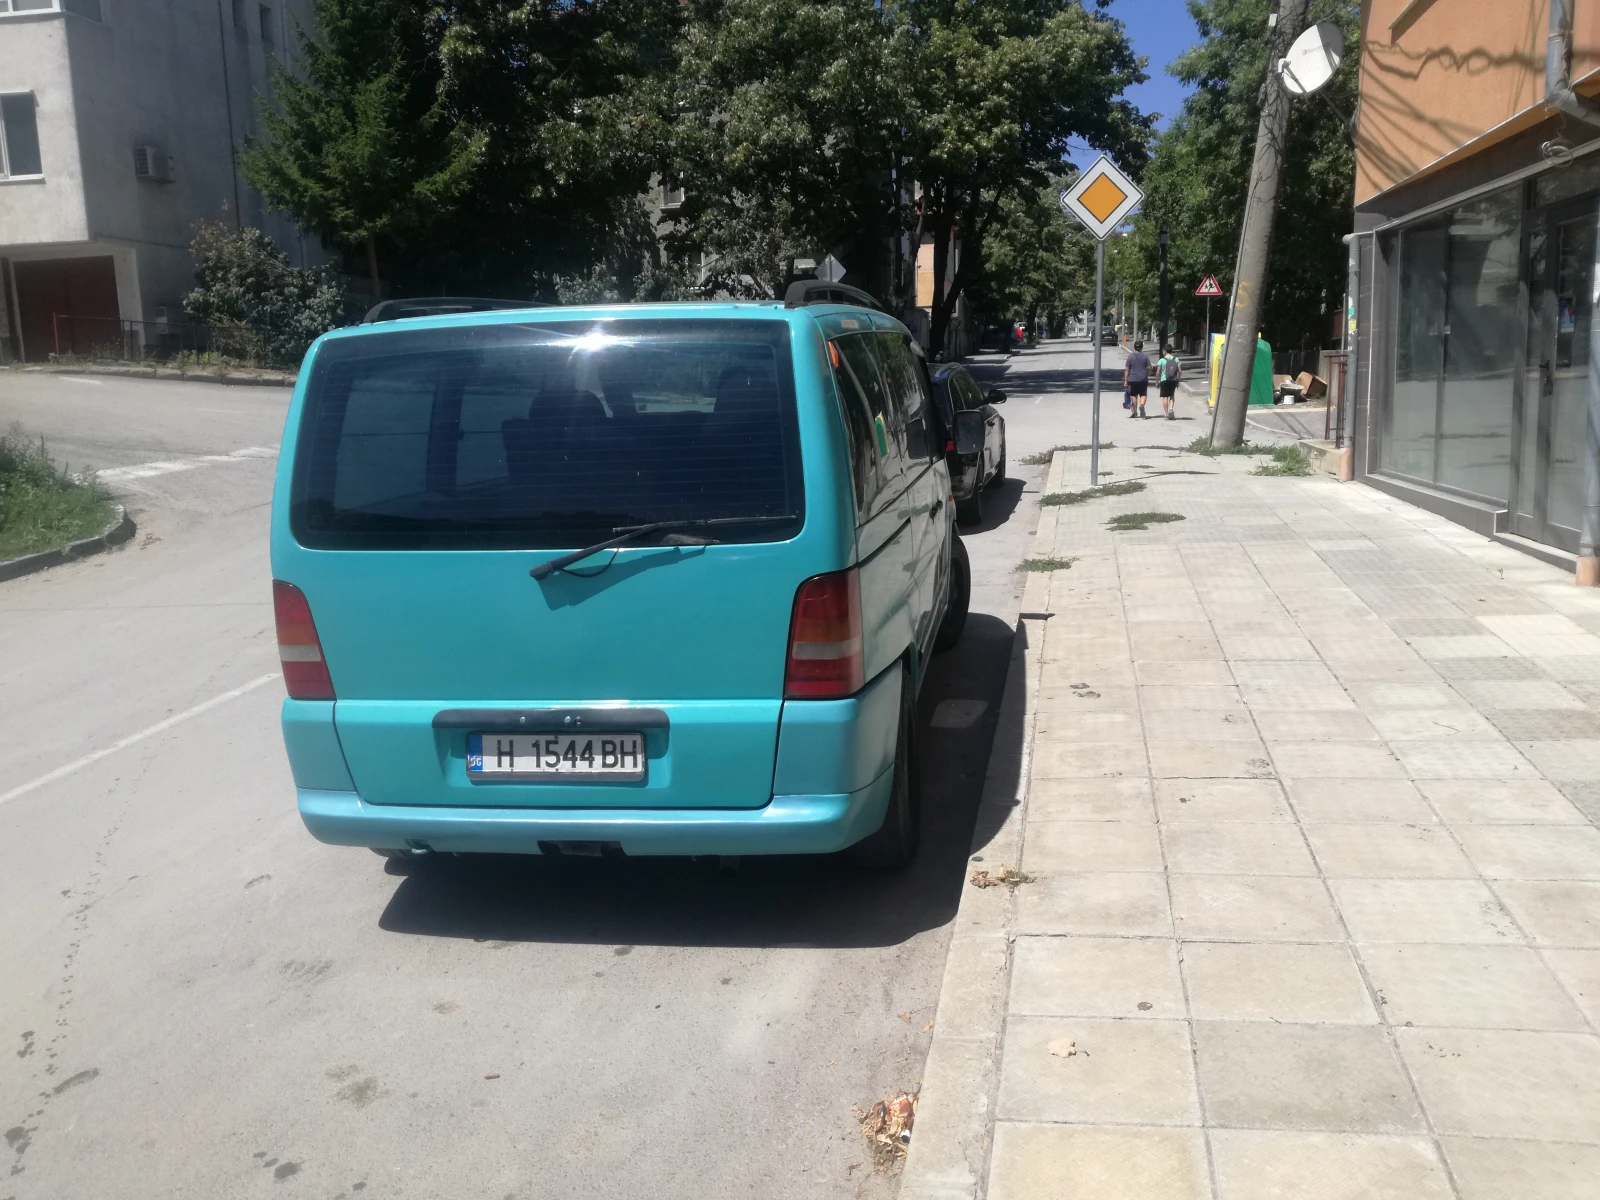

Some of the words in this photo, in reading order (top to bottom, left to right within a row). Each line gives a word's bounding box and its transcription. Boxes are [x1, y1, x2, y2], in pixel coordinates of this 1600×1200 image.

[496, 739, 514, 768] H
[532, 739, 595, 769] 1544
[601, 739, 638, 769] BH
